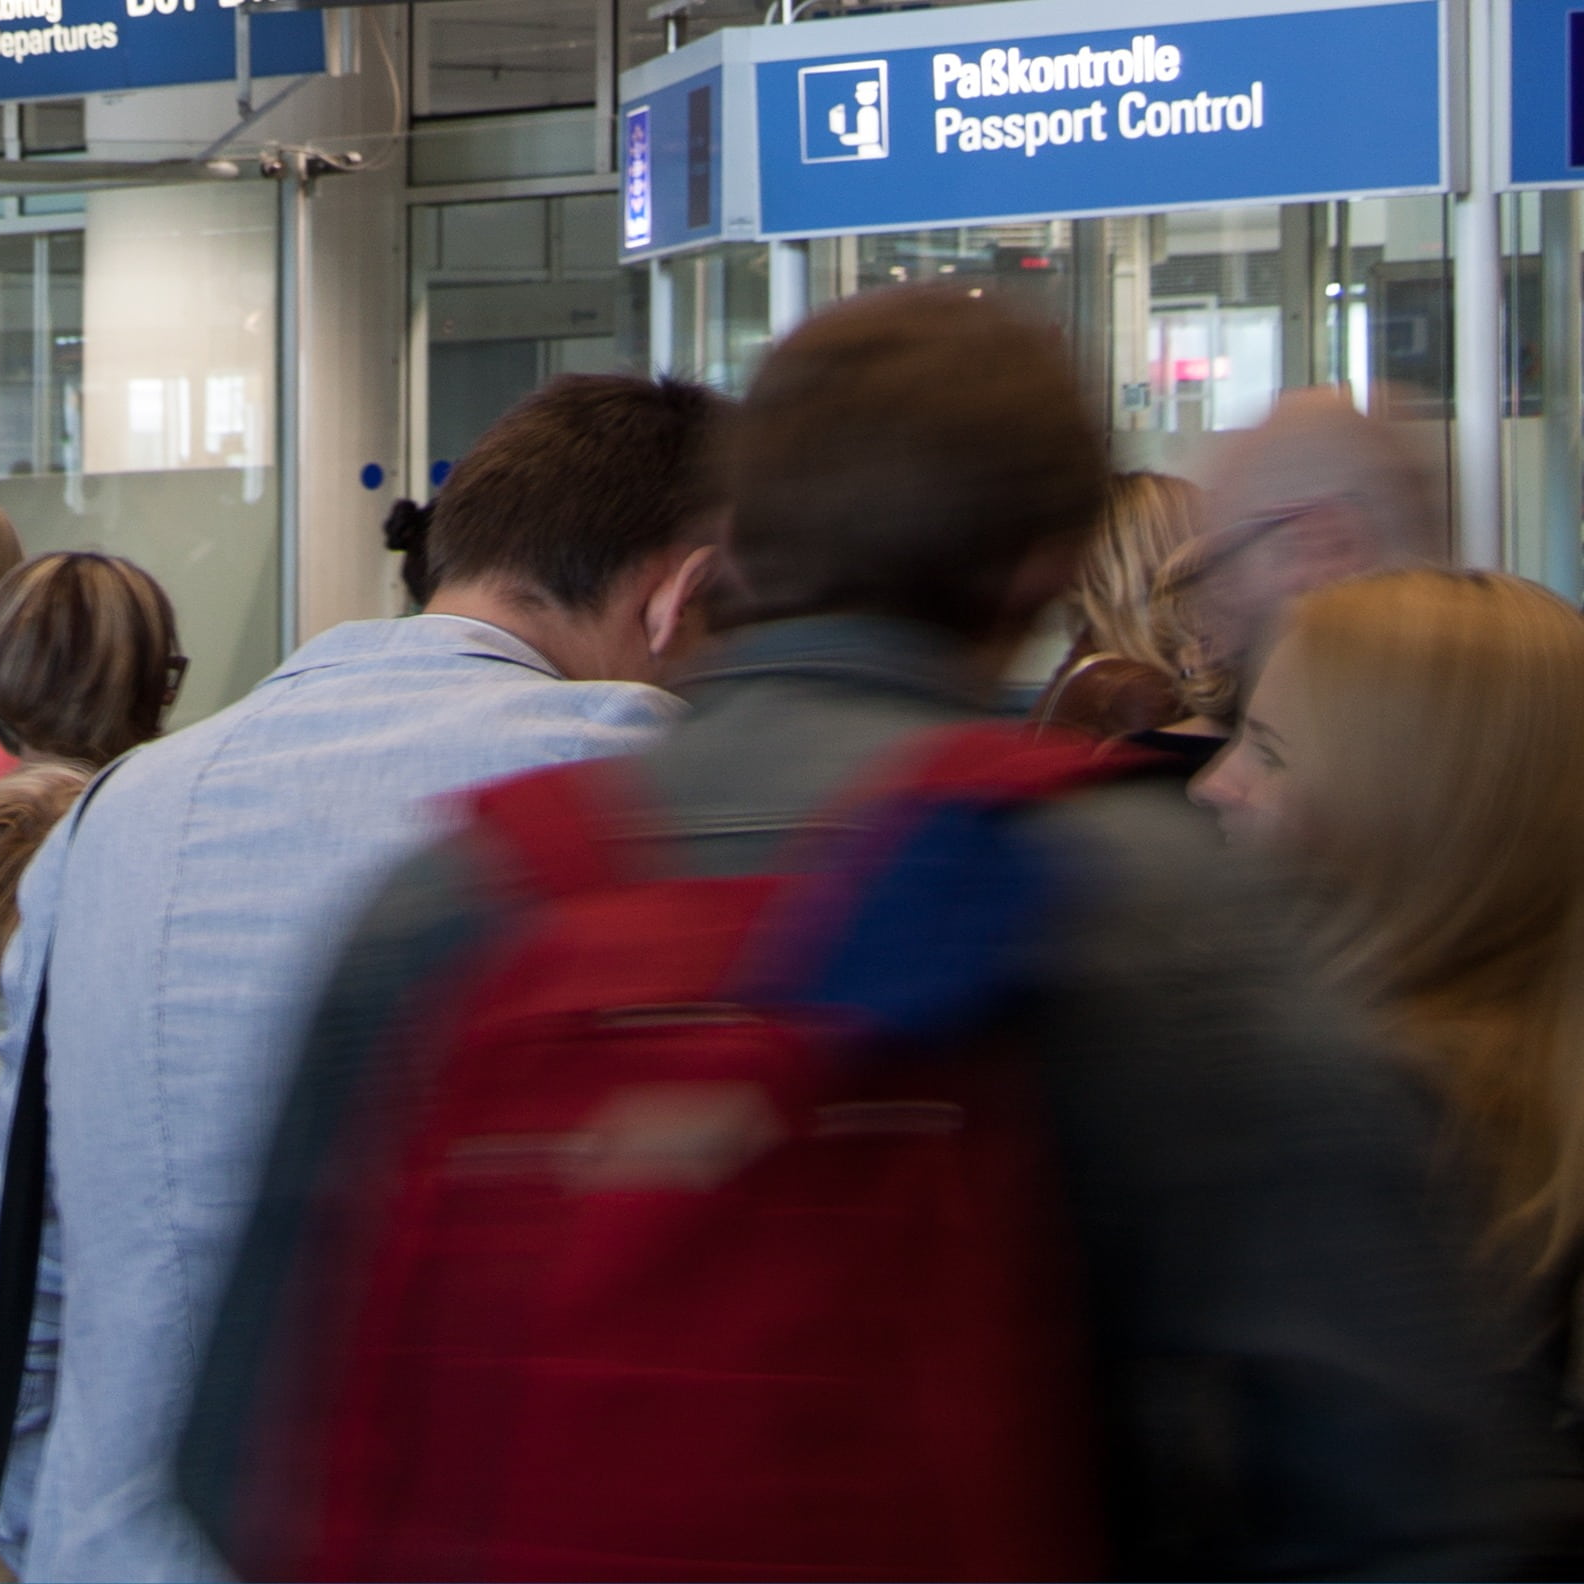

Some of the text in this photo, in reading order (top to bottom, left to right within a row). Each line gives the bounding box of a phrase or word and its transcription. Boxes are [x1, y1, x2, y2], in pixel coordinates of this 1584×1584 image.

[932, 34, 1181, 101] Paßkontrolle
[935, 81, 1263, 157] Passport Control
